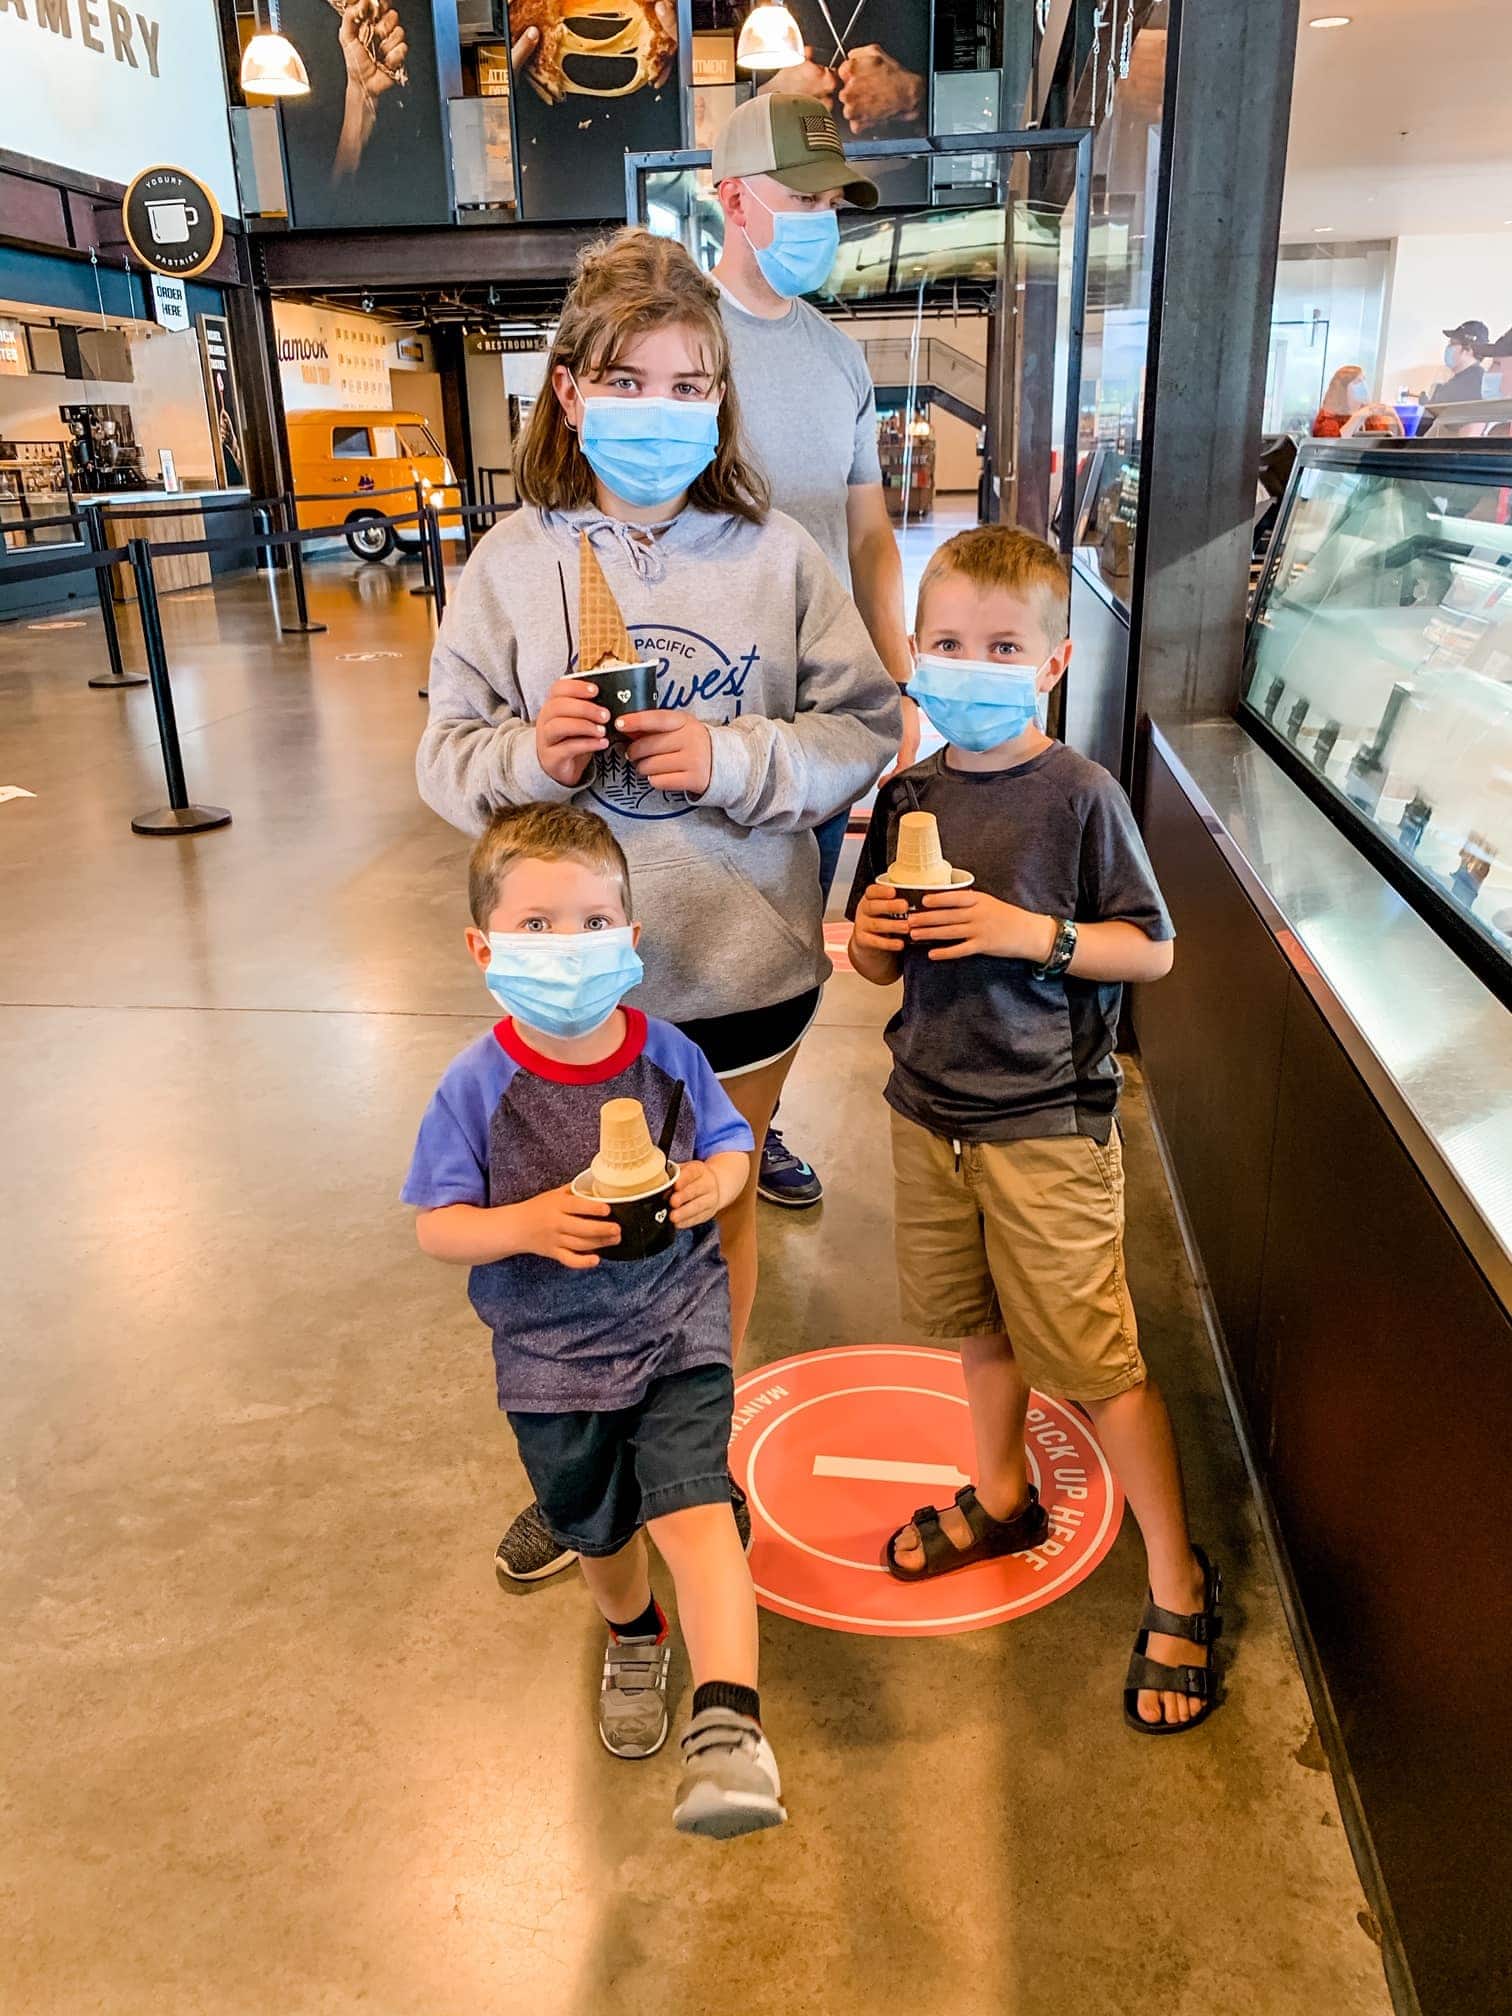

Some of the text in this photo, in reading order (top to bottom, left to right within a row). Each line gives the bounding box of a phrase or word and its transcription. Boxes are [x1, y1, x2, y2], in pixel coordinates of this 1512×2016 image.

[146, 175, 182, 188] YOGURT
[155, 251, 199, 266] PASTRIES
[156, 286, 183, 300] ORDER
[162, 303, 182, 316] HERE
[277, 328, 329, 362] lamook
[634, 638, 697, 659] PACIFIC
[656, 643, 761, 710] west
[1011, 1407, 1089, 1573] PICK UP HERE
